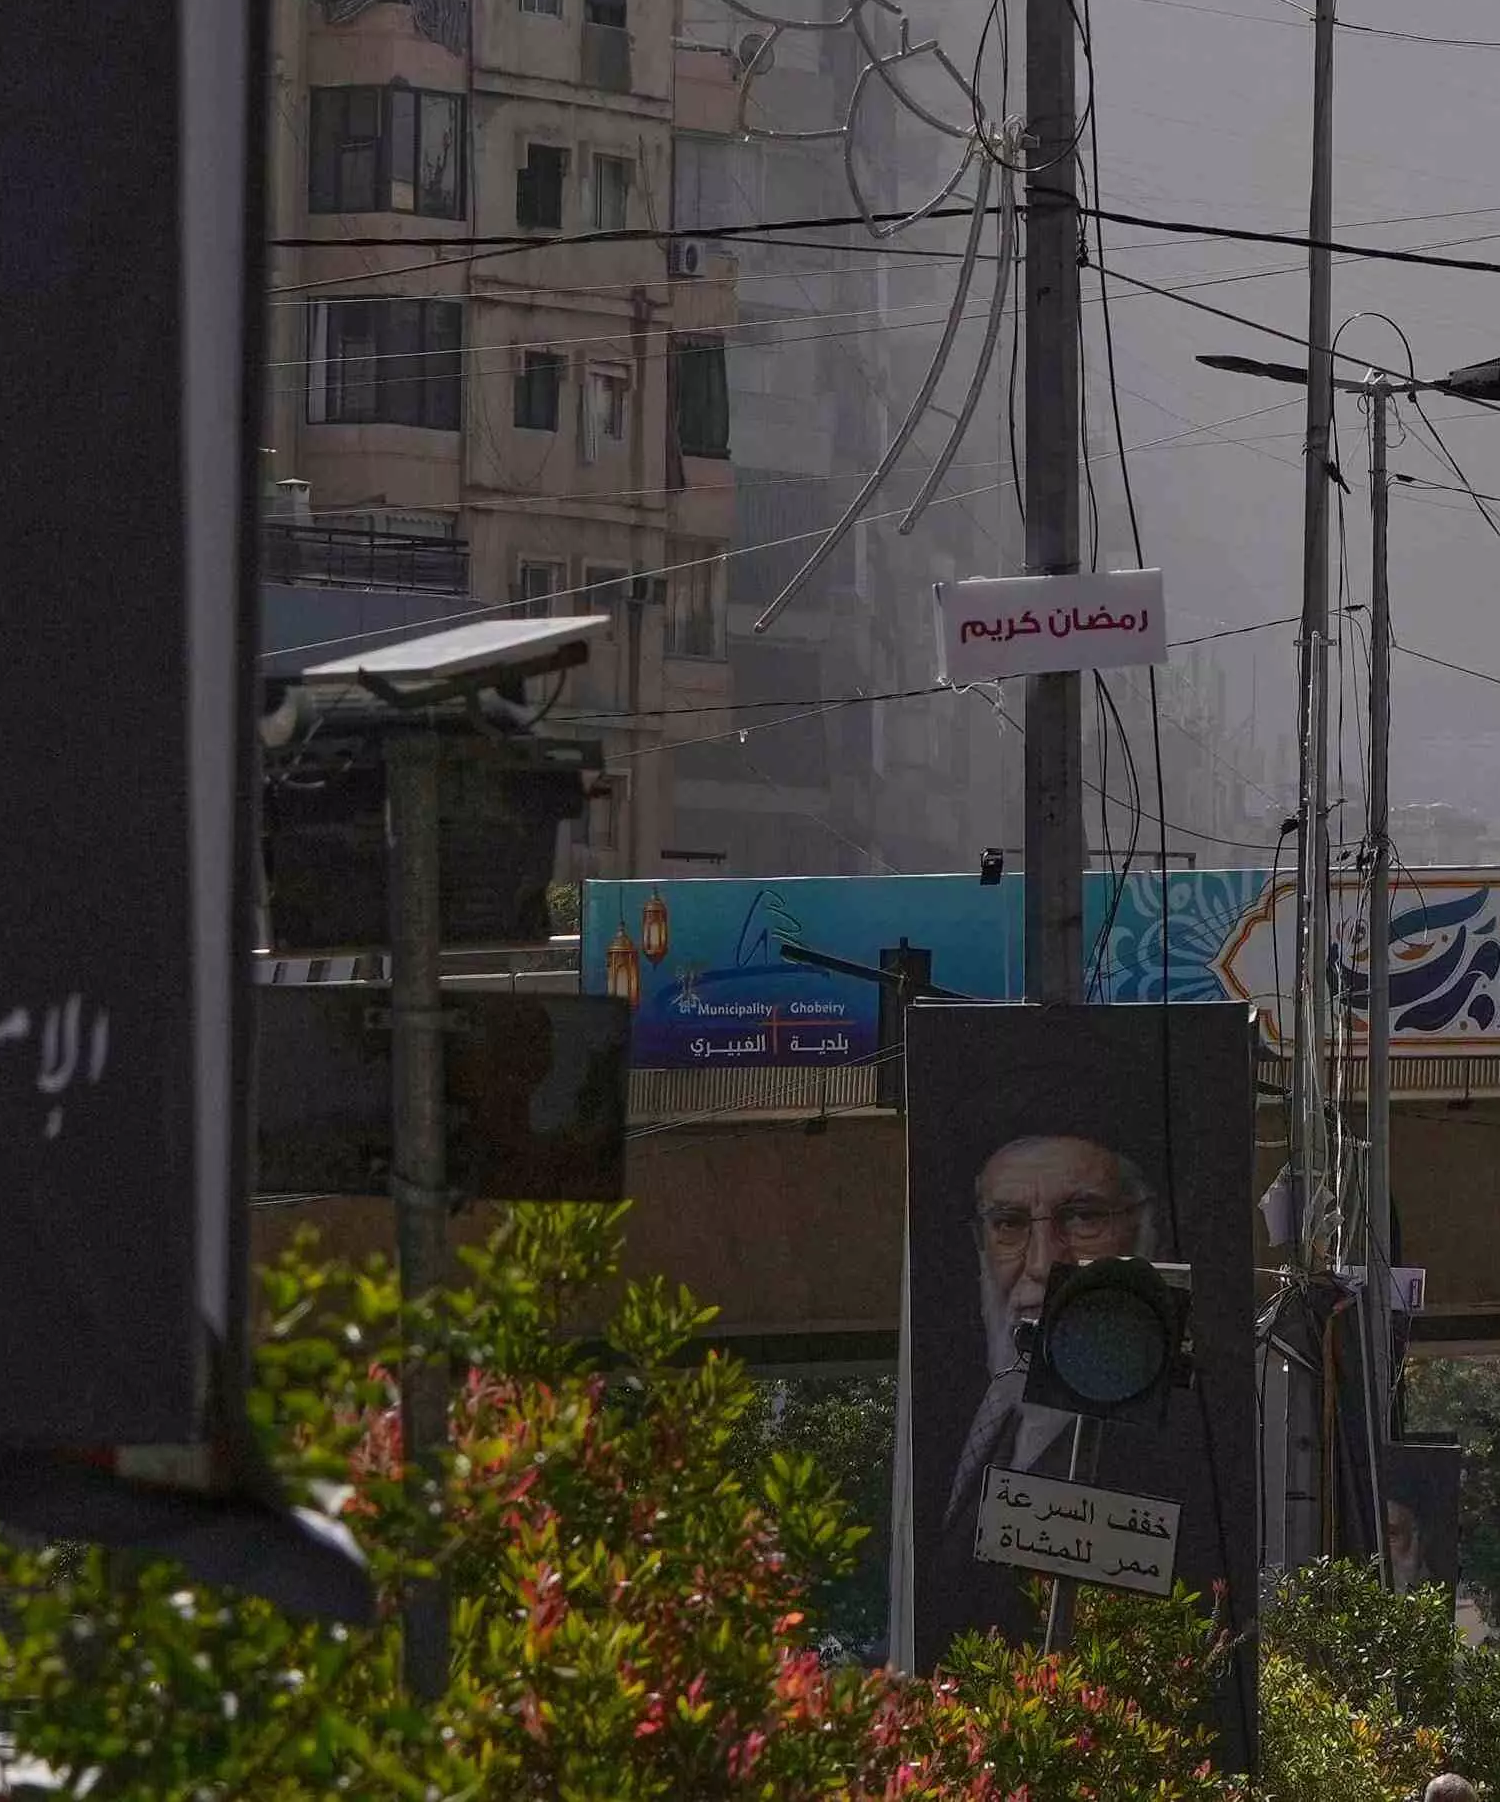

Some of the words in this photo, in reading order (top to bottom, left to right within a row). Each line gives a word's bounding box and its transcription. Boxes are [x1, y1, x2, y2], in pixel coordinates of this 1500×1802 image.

[961, 610, 1041, 644] كريم
[1048, 606, 1148, 637] رمضان
[698, 1001, 772, 1018] Municipality
[789, 1001, 846, 1017] Ghobeiry
[689, 1034, 766, 1057] الغبيري
[790, 1032, 849, 1055] بلدية
[996, 1478, 1094, 1525] السرعة
[1107, 1508, 1171, 1540] خفف
[999, 1524, 1092, 1563] للمشاة
[1102, 1558, 1159, 1577] ممر
